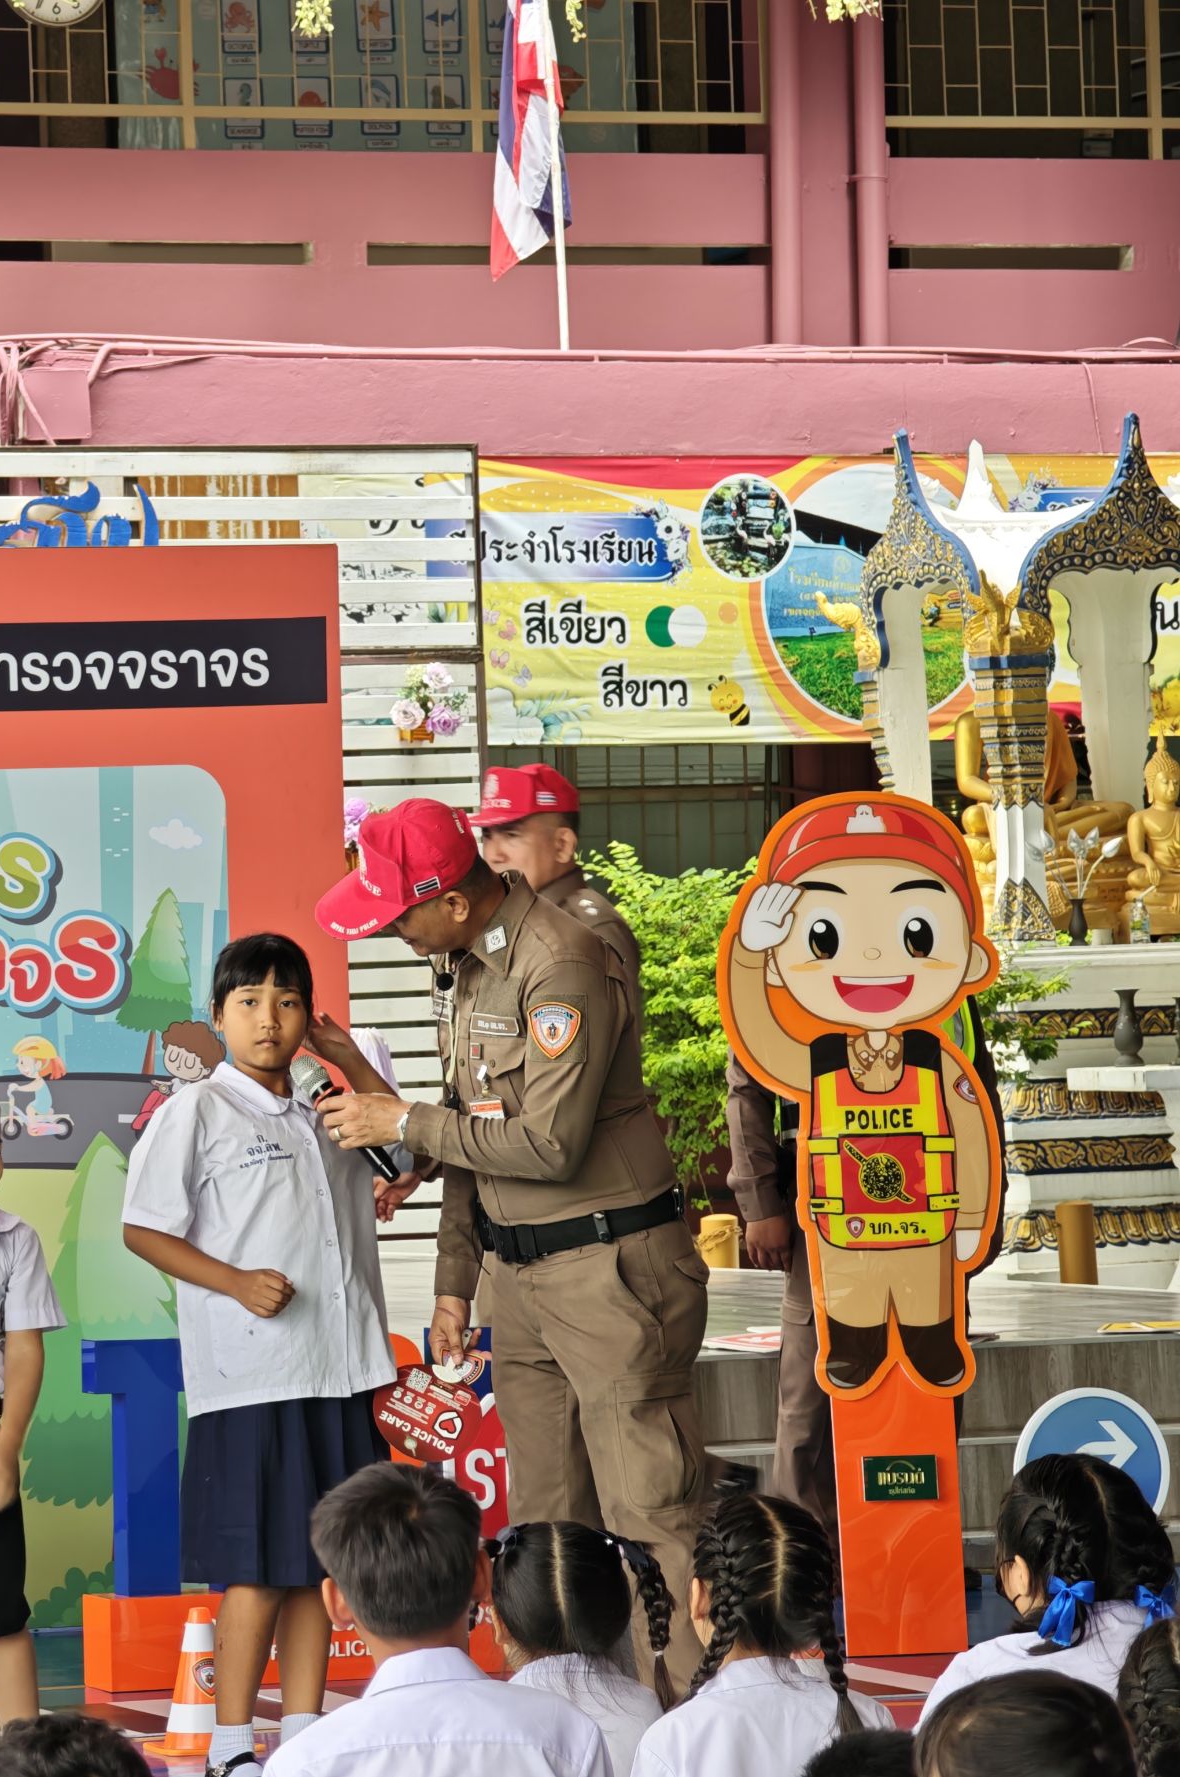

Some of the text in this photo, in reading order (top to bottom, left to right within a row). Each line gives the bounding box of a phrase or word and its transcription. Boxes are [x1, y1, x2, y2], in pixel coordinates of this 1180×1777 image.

[524, 600, 626, 644] สีเขียว
[602, 664, 688, 708] สีขาว
[844, 1108, 914, 1130] POLICE
[869, 1220, 927, 1235] บก.จร.
[379, 1410, 411, 1432] CARE
[411, 1426, 455, 1455] POLICE
